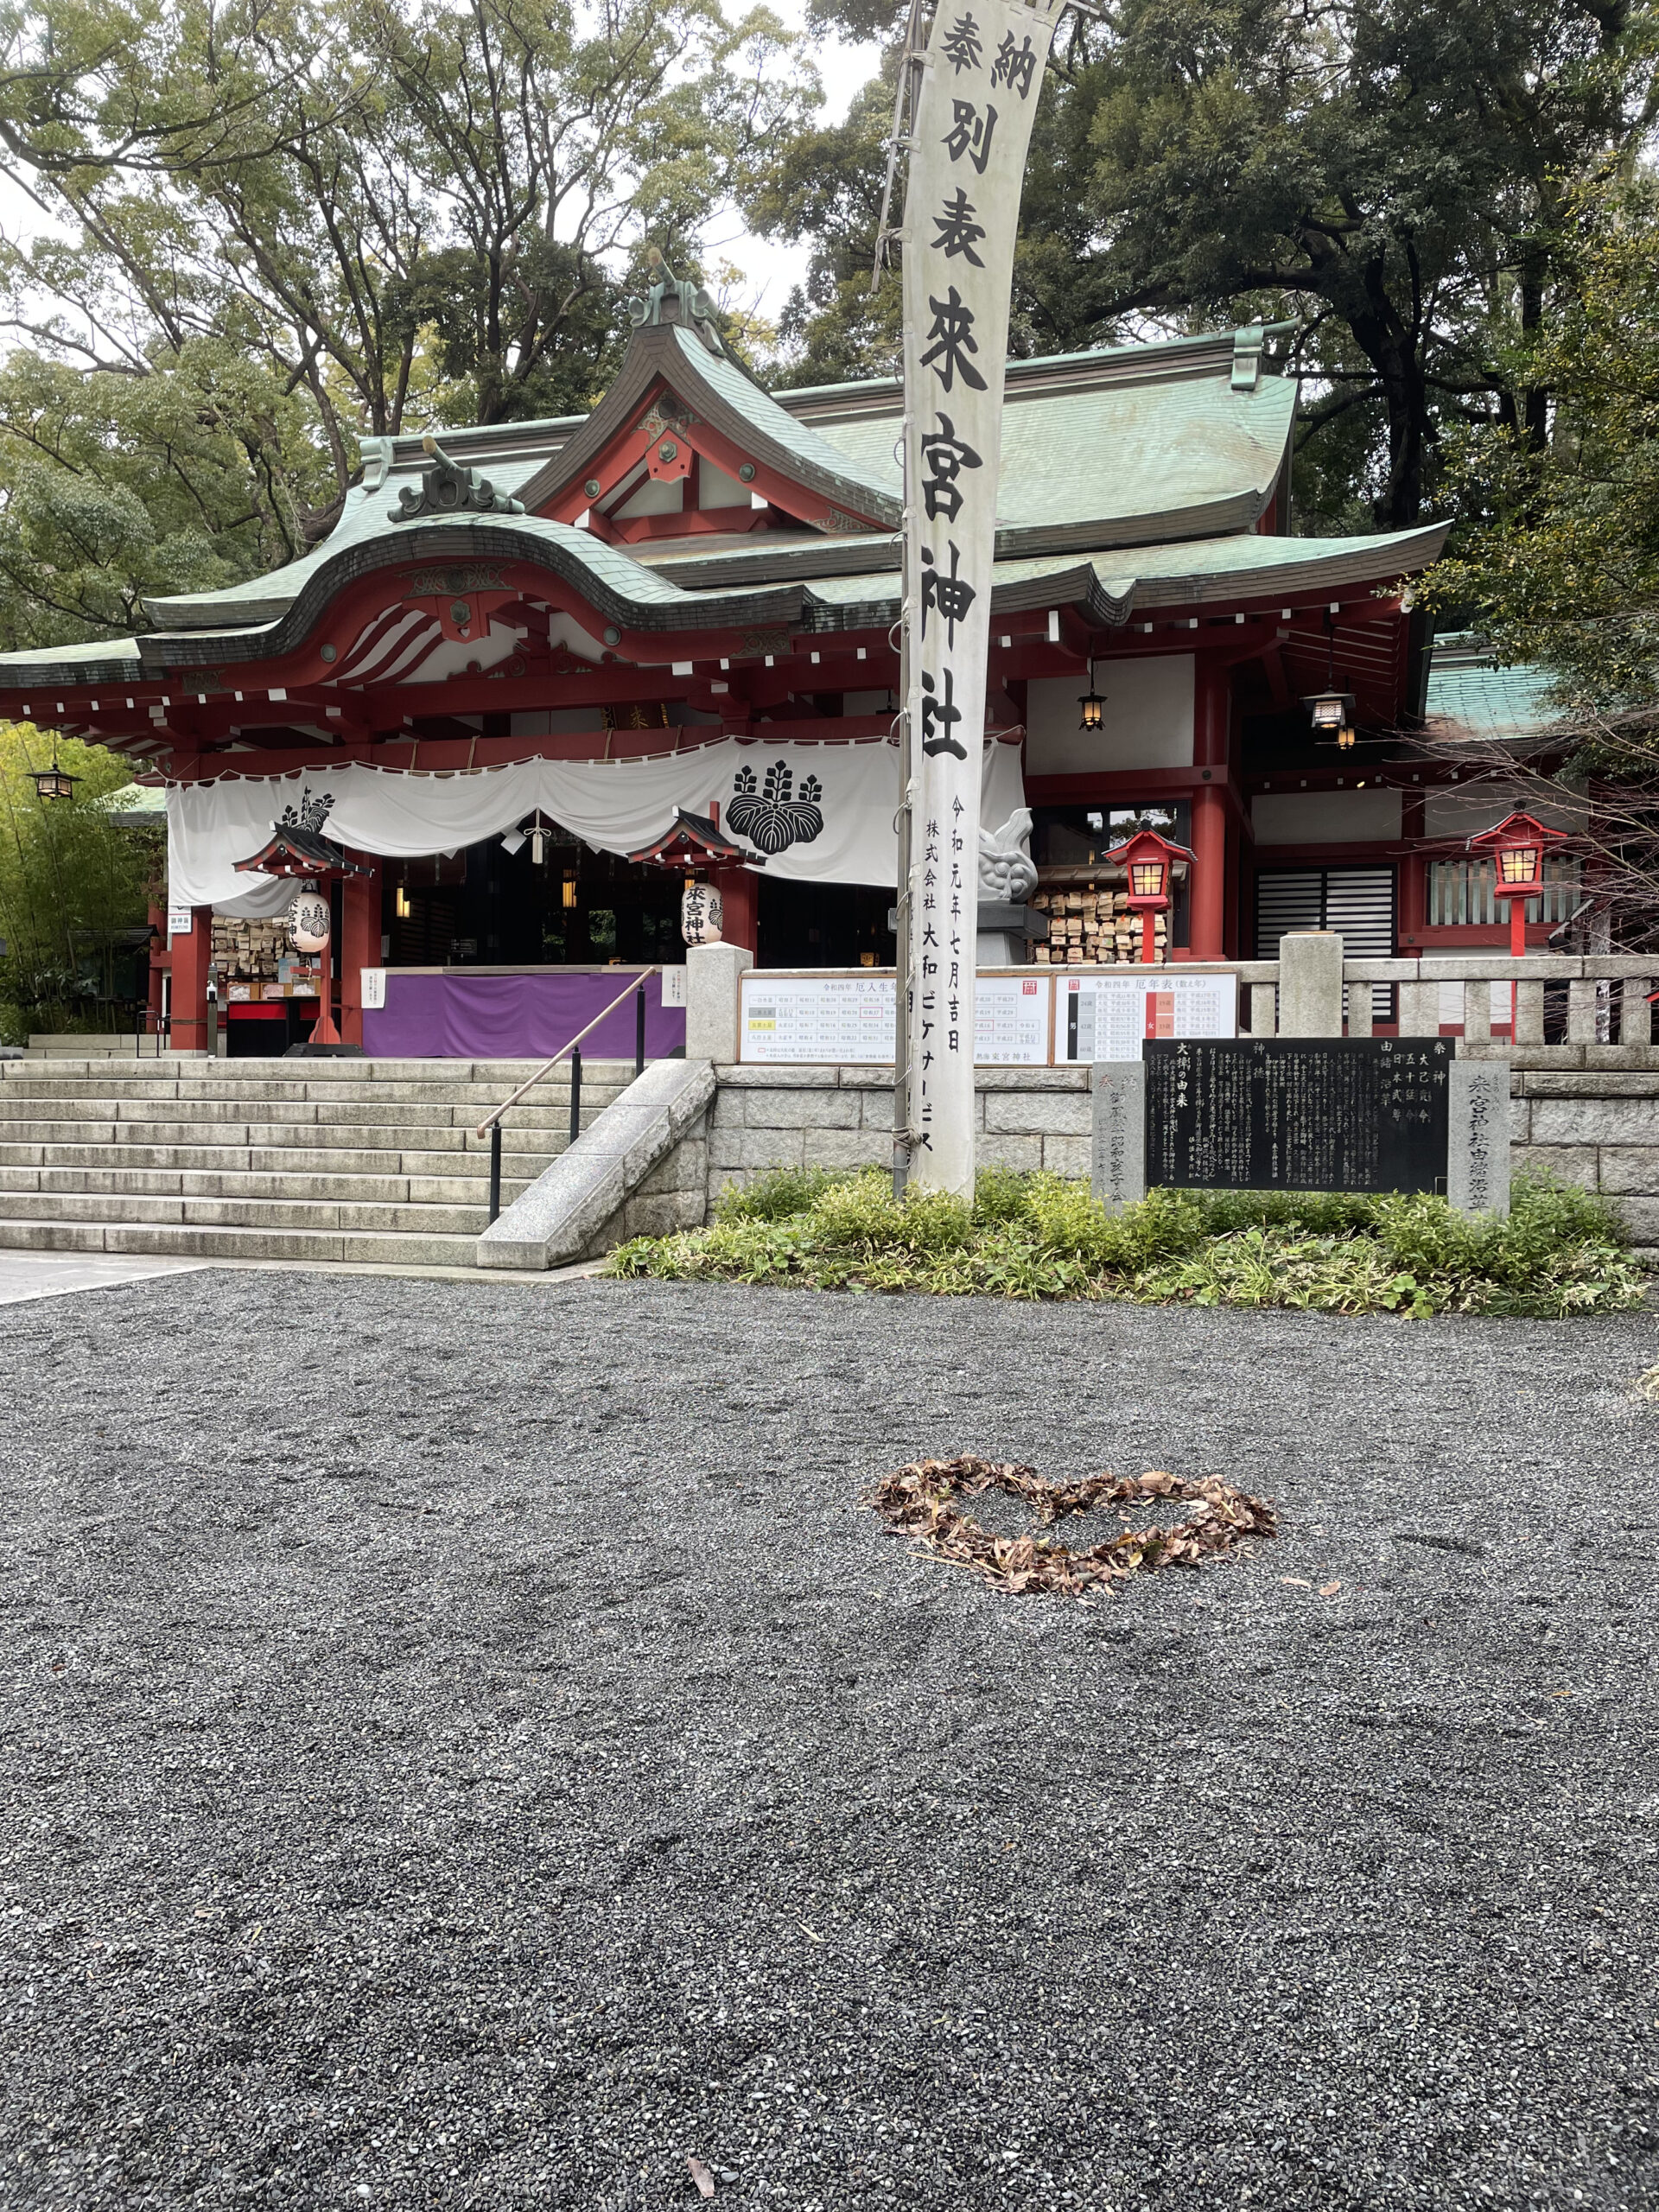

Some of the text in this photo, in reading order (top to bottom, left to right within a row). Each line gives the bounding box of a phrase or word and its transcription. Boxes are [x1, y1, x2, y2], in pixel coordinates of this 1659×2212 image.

[939, 11, 1037, 100] 奉納
[948, 795, 965, 1053] 令和元年七月吉日
[1433, 1041, 1446, 1086] 祭神
